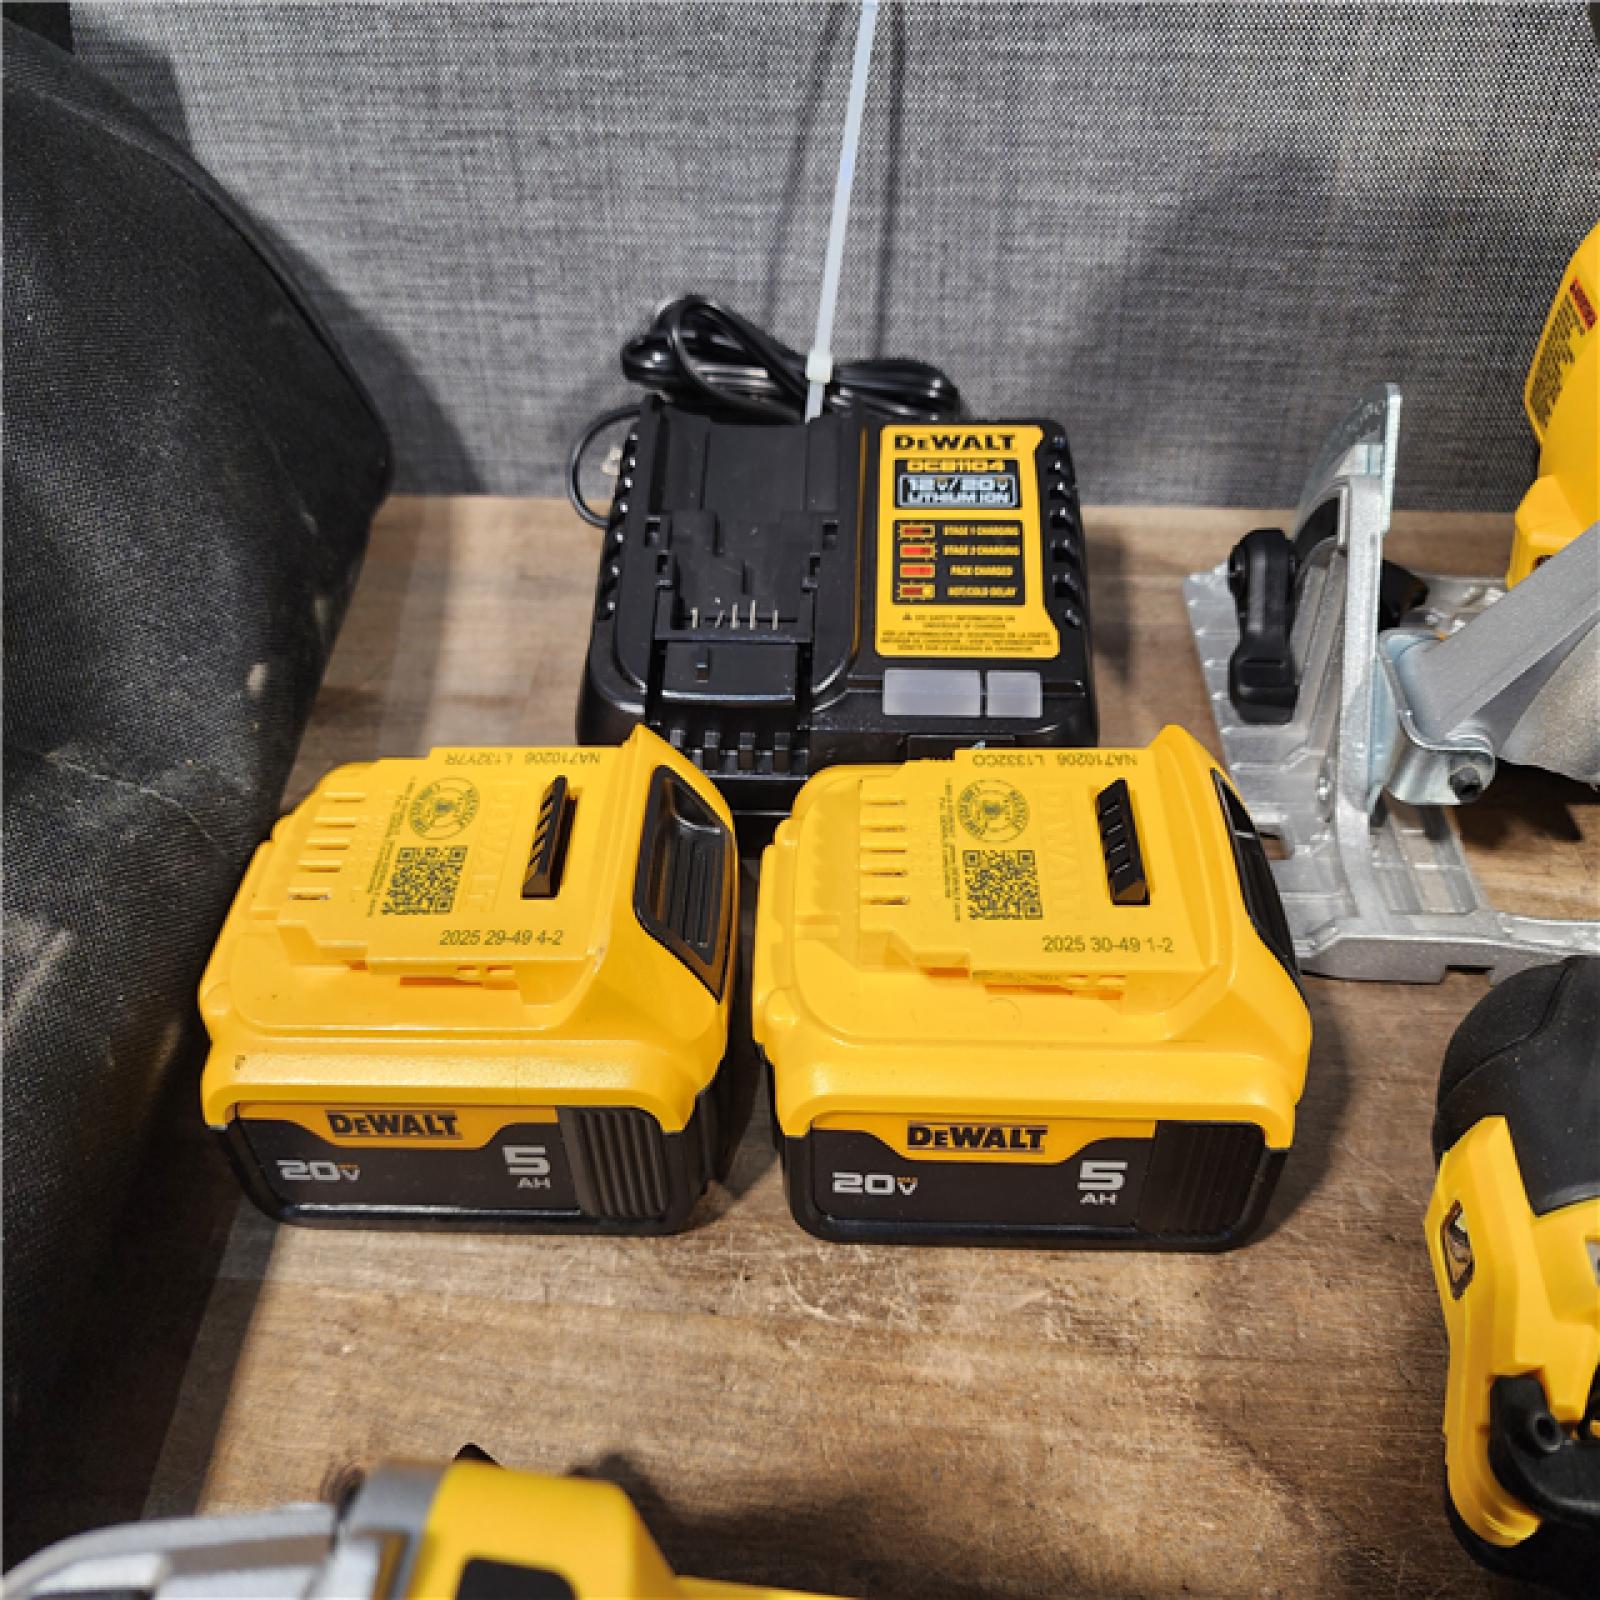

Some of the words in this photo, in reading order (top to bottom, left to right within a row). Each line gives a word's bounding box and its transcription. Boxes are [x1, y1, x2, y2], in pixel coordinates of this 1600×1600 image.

[894, 434, 1016, 450] DEWALT
[439, 929, 481, 946] 2025
[536, 929, 563, 946] 4-2
[1042, 934, 1086, 953] 2025
[1144, 936, 1175, 953] 1-2
[327, 1113, 458, 1136] DEWALT
[907, 1126, 1048, 1149] DEWALT
[502, 1144, 550, 1176] 5
[517, 1177, 550, 1189] AH
[832, 1171, 918, 1196] 20V
[1077, 1160, 1128, 1191] 5
[1079, 1194, 1116, 1206] AH
